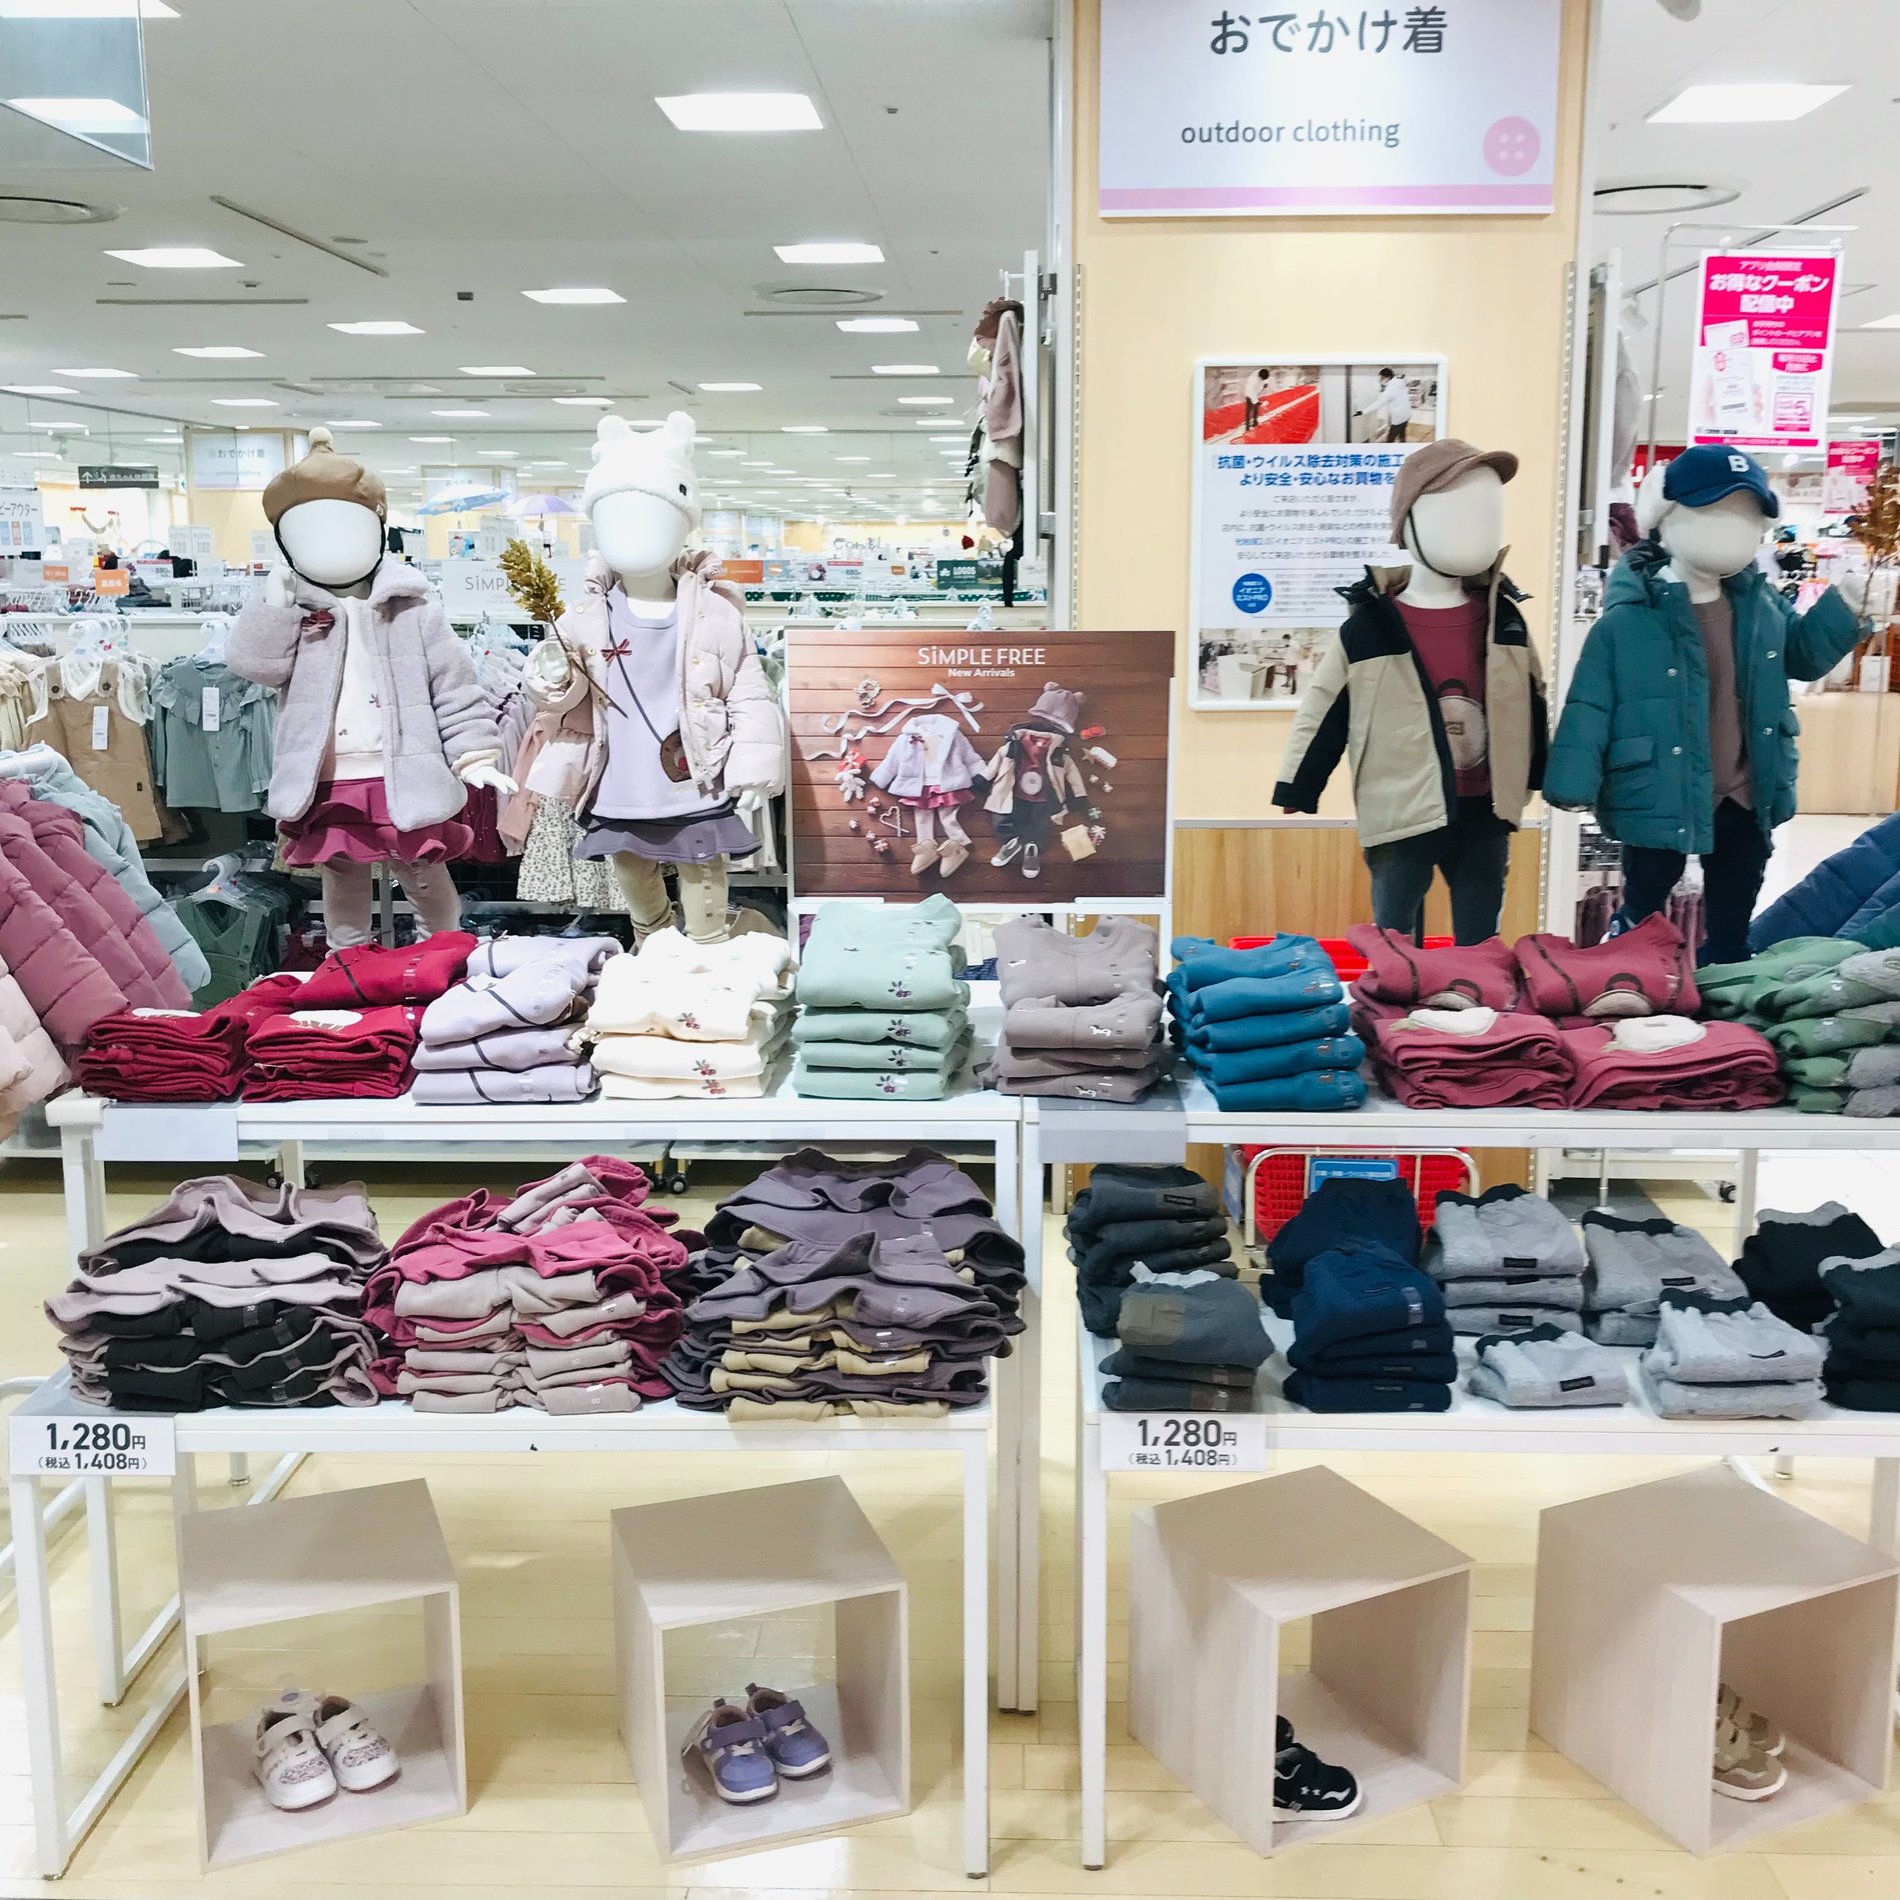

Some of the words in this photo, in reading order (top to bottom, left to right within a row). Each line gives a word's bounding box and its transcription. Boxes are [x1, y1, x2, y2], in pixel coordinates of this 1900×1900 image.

[1210, 6, 1448, 54] おでかけ着
[1181, 120, 1284, 143] outdoor
[1293, 119, 1400, 148] clothing
[1709, 273, 1829, 292] お得なクーポン
[1727, 455, 1750, 472] B
[917, 646, 993, 665] SiMPLE
[997, 648, 1046, 665] FREE
[948, 669, 971, 677] New
[974, 668, 1016, 677] Arrivals
[46, 1423, 146, 1451] 1,280円
[1138, 1419, 1237, 1447] 1,280円
